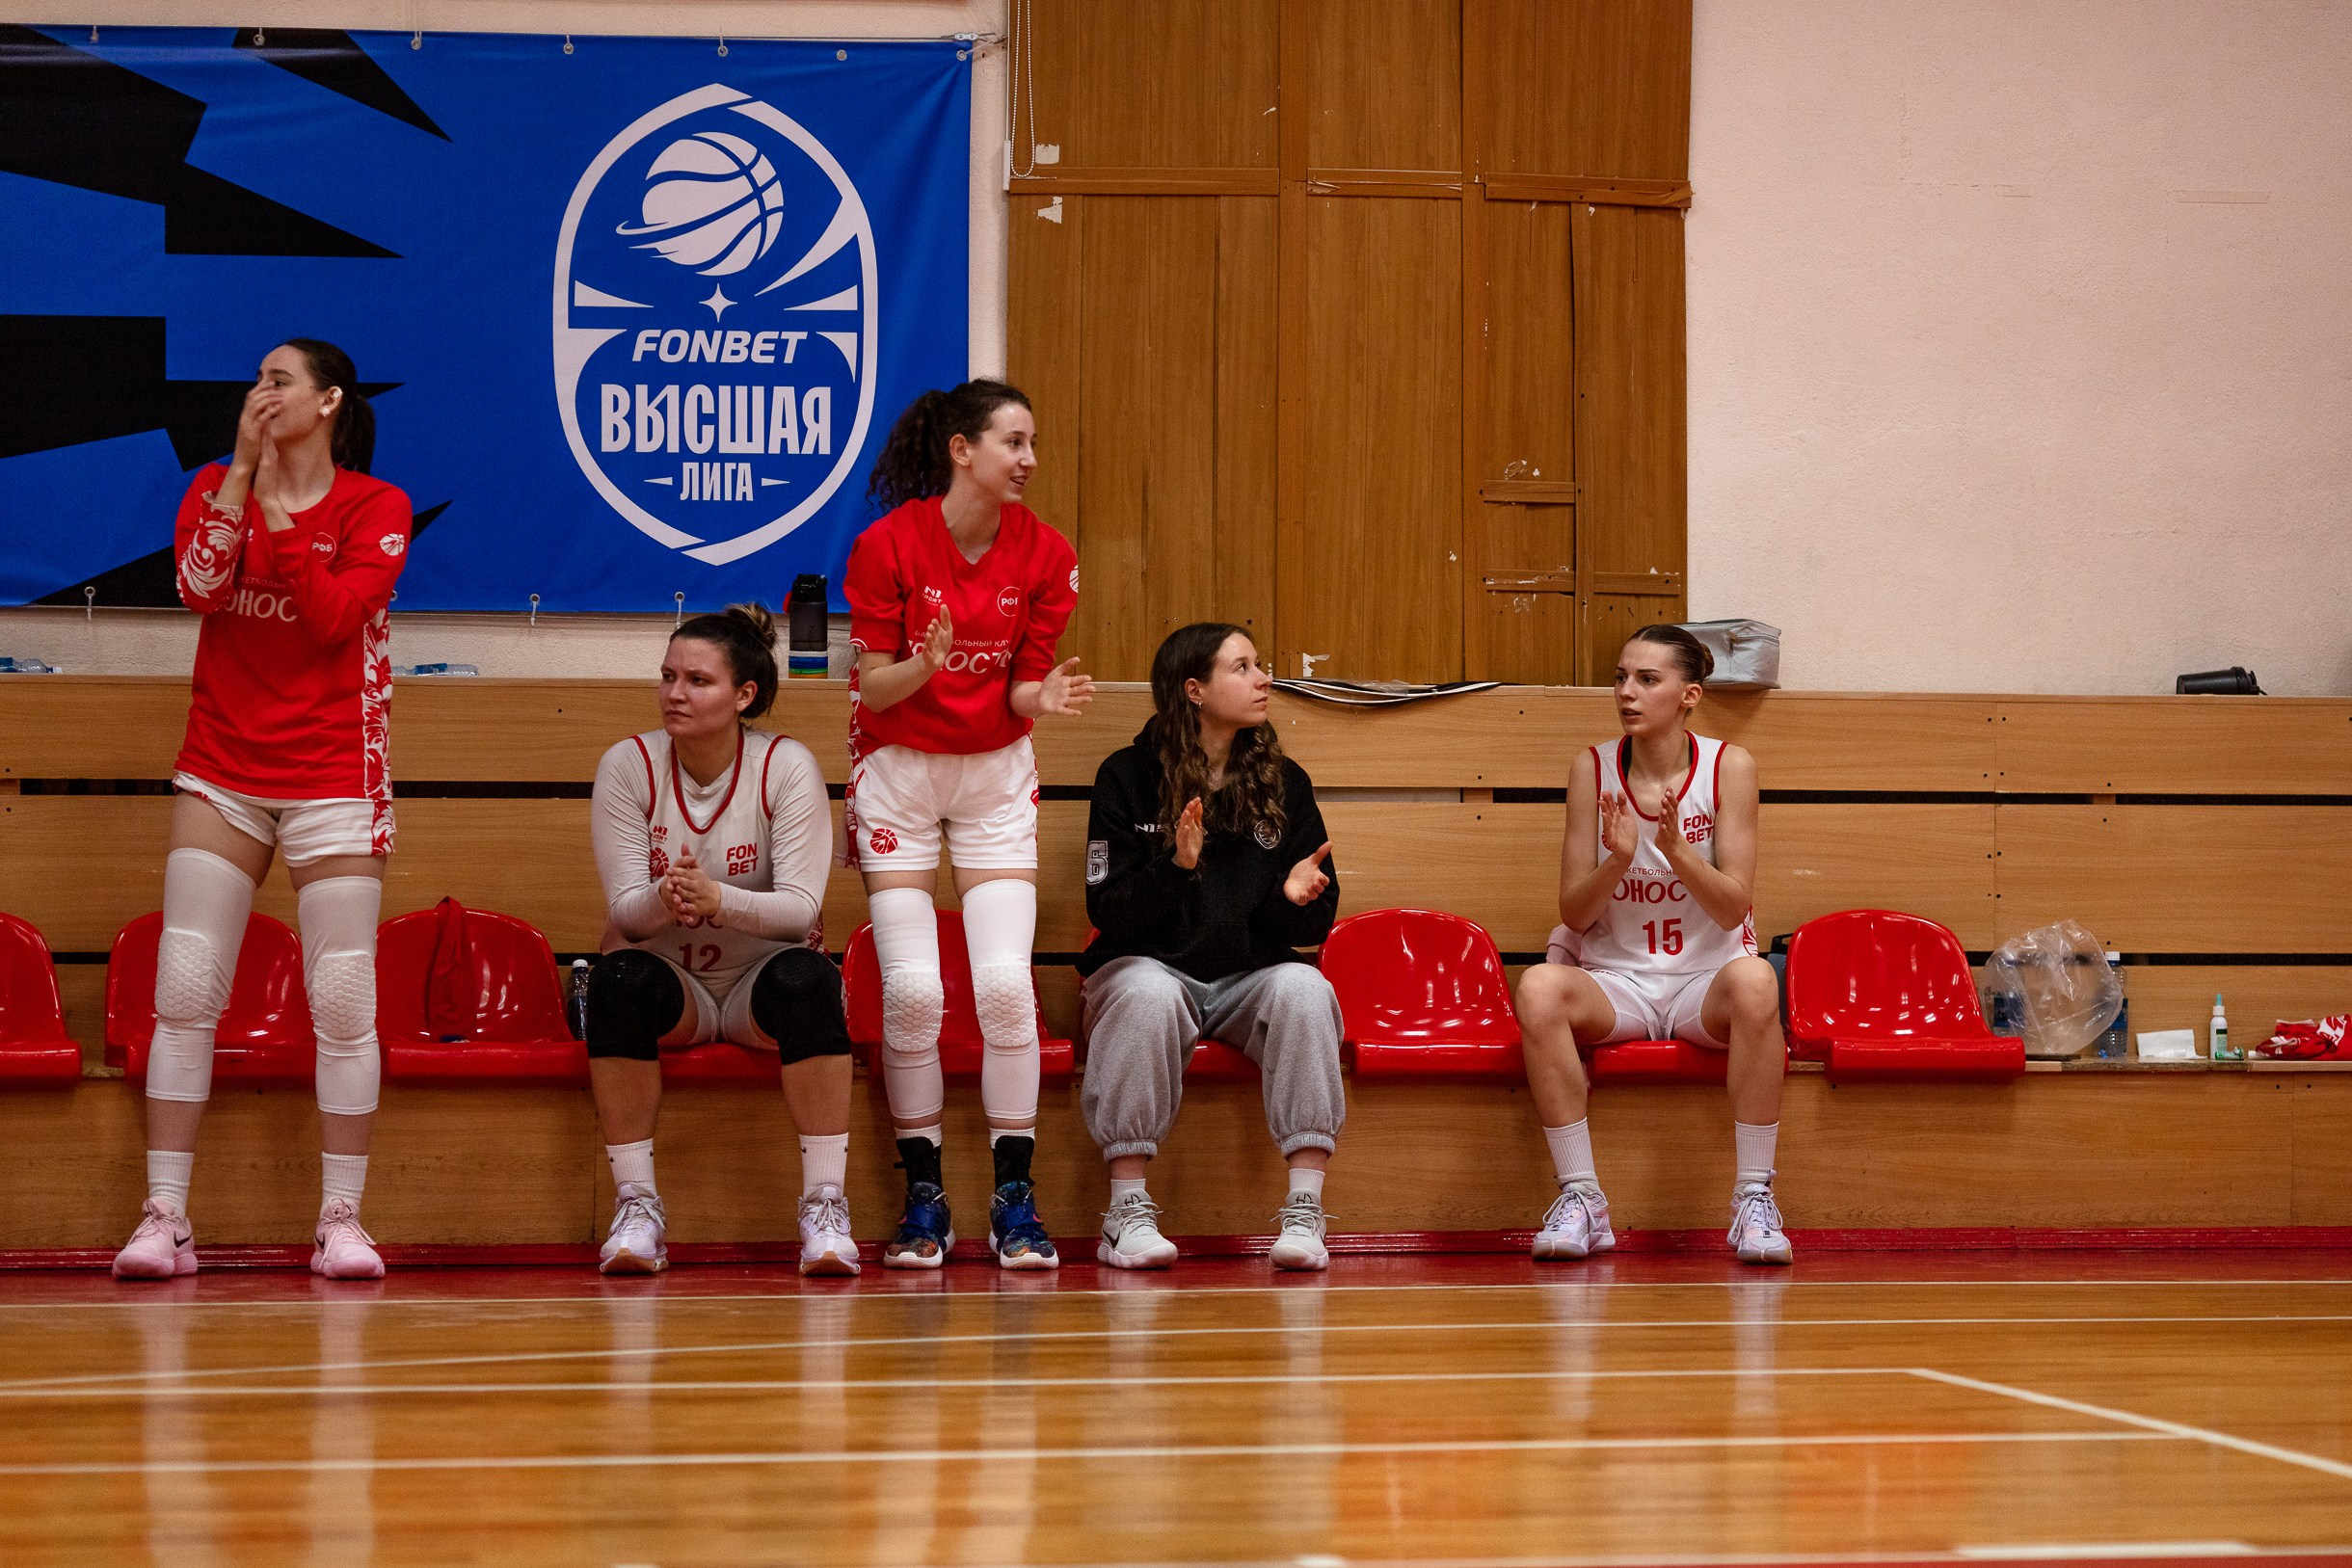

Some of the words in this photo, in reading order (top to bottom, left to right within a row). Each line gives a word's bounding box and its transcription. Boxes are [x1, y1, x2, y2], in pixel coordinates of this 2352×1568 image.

[632, 329, 808, 364] FONBET
[601, 384, 832, 456] ВЫСШАЯ
[680, 461, 755, 502] ЛИГА
[312, 542, 334, 553] РФБ
[1683, 813, 1713, 832] FON
[1685, 826, 1715, 845] BET
[726, 842, 759, 863] FON
[727, 856, 760, 877] BET
[1642, 917, 1685, 956] 15
[678, 943, 723, 972] 12
